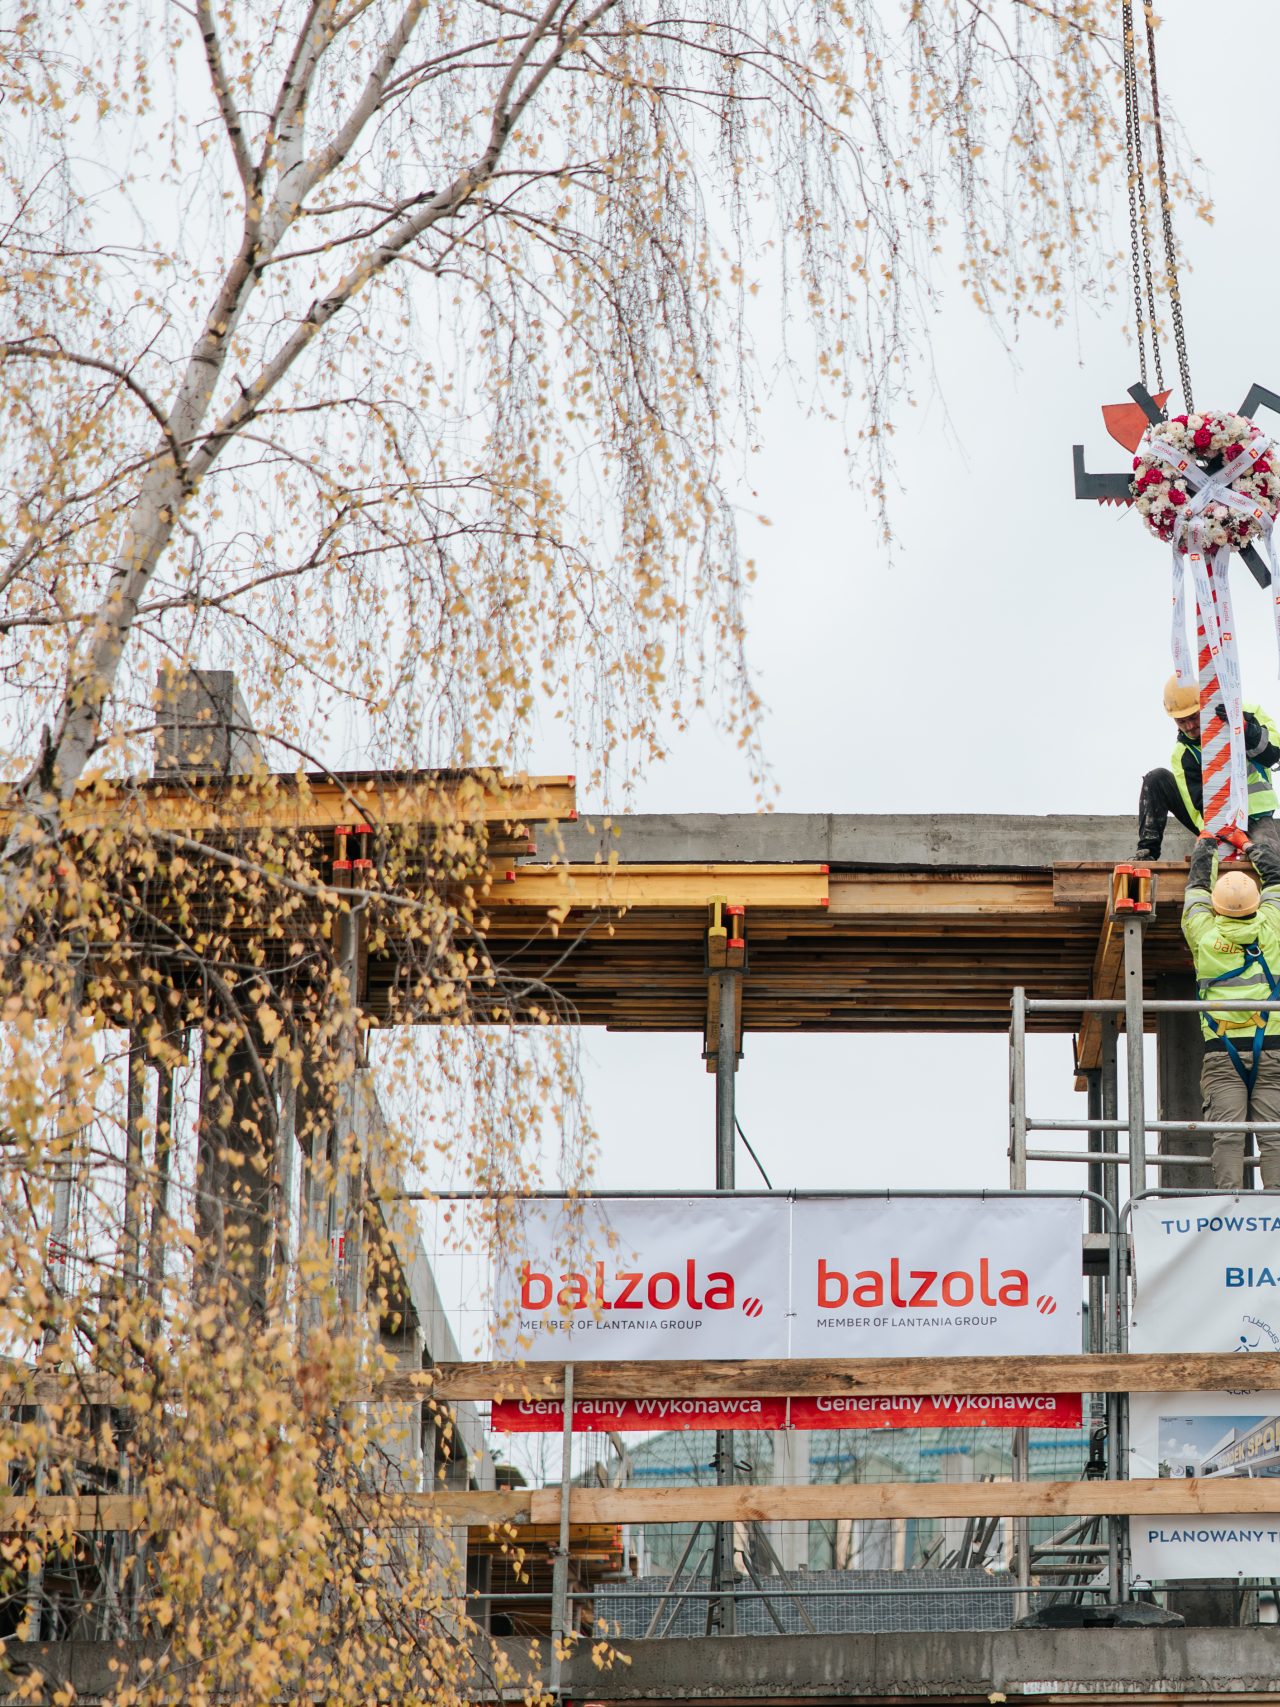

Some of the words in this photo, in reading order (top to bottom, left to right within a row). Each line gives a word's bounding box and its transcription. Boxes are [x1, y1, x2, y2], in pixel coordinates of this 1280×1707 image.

[1161, 1219, 1190, 1235] TU
[520, 1258, 735, 1311] balzola
[817, 1257, 1029, 1310] balzola
[577, 1320, 594, 1330] OF
[596, 1319, 658, 1330] LANTANIA
[661, 1319, 703, 1330] GROUP
[816, 1318, 870, 1328] MEMBER
[873, 1318, 889, 1328] OF
[891, 1317, 952, 1328] LANTANIA
[955, 1316, 998, 1327] GROUP
[634, 1398, 762, 1415] Wykonawca
[816, 1395, 923, 1414] Generalny
[931, 1393, 1057, 1411] Wykonawca
[1148, 1530, 1264, 1543] PLANOWANY
